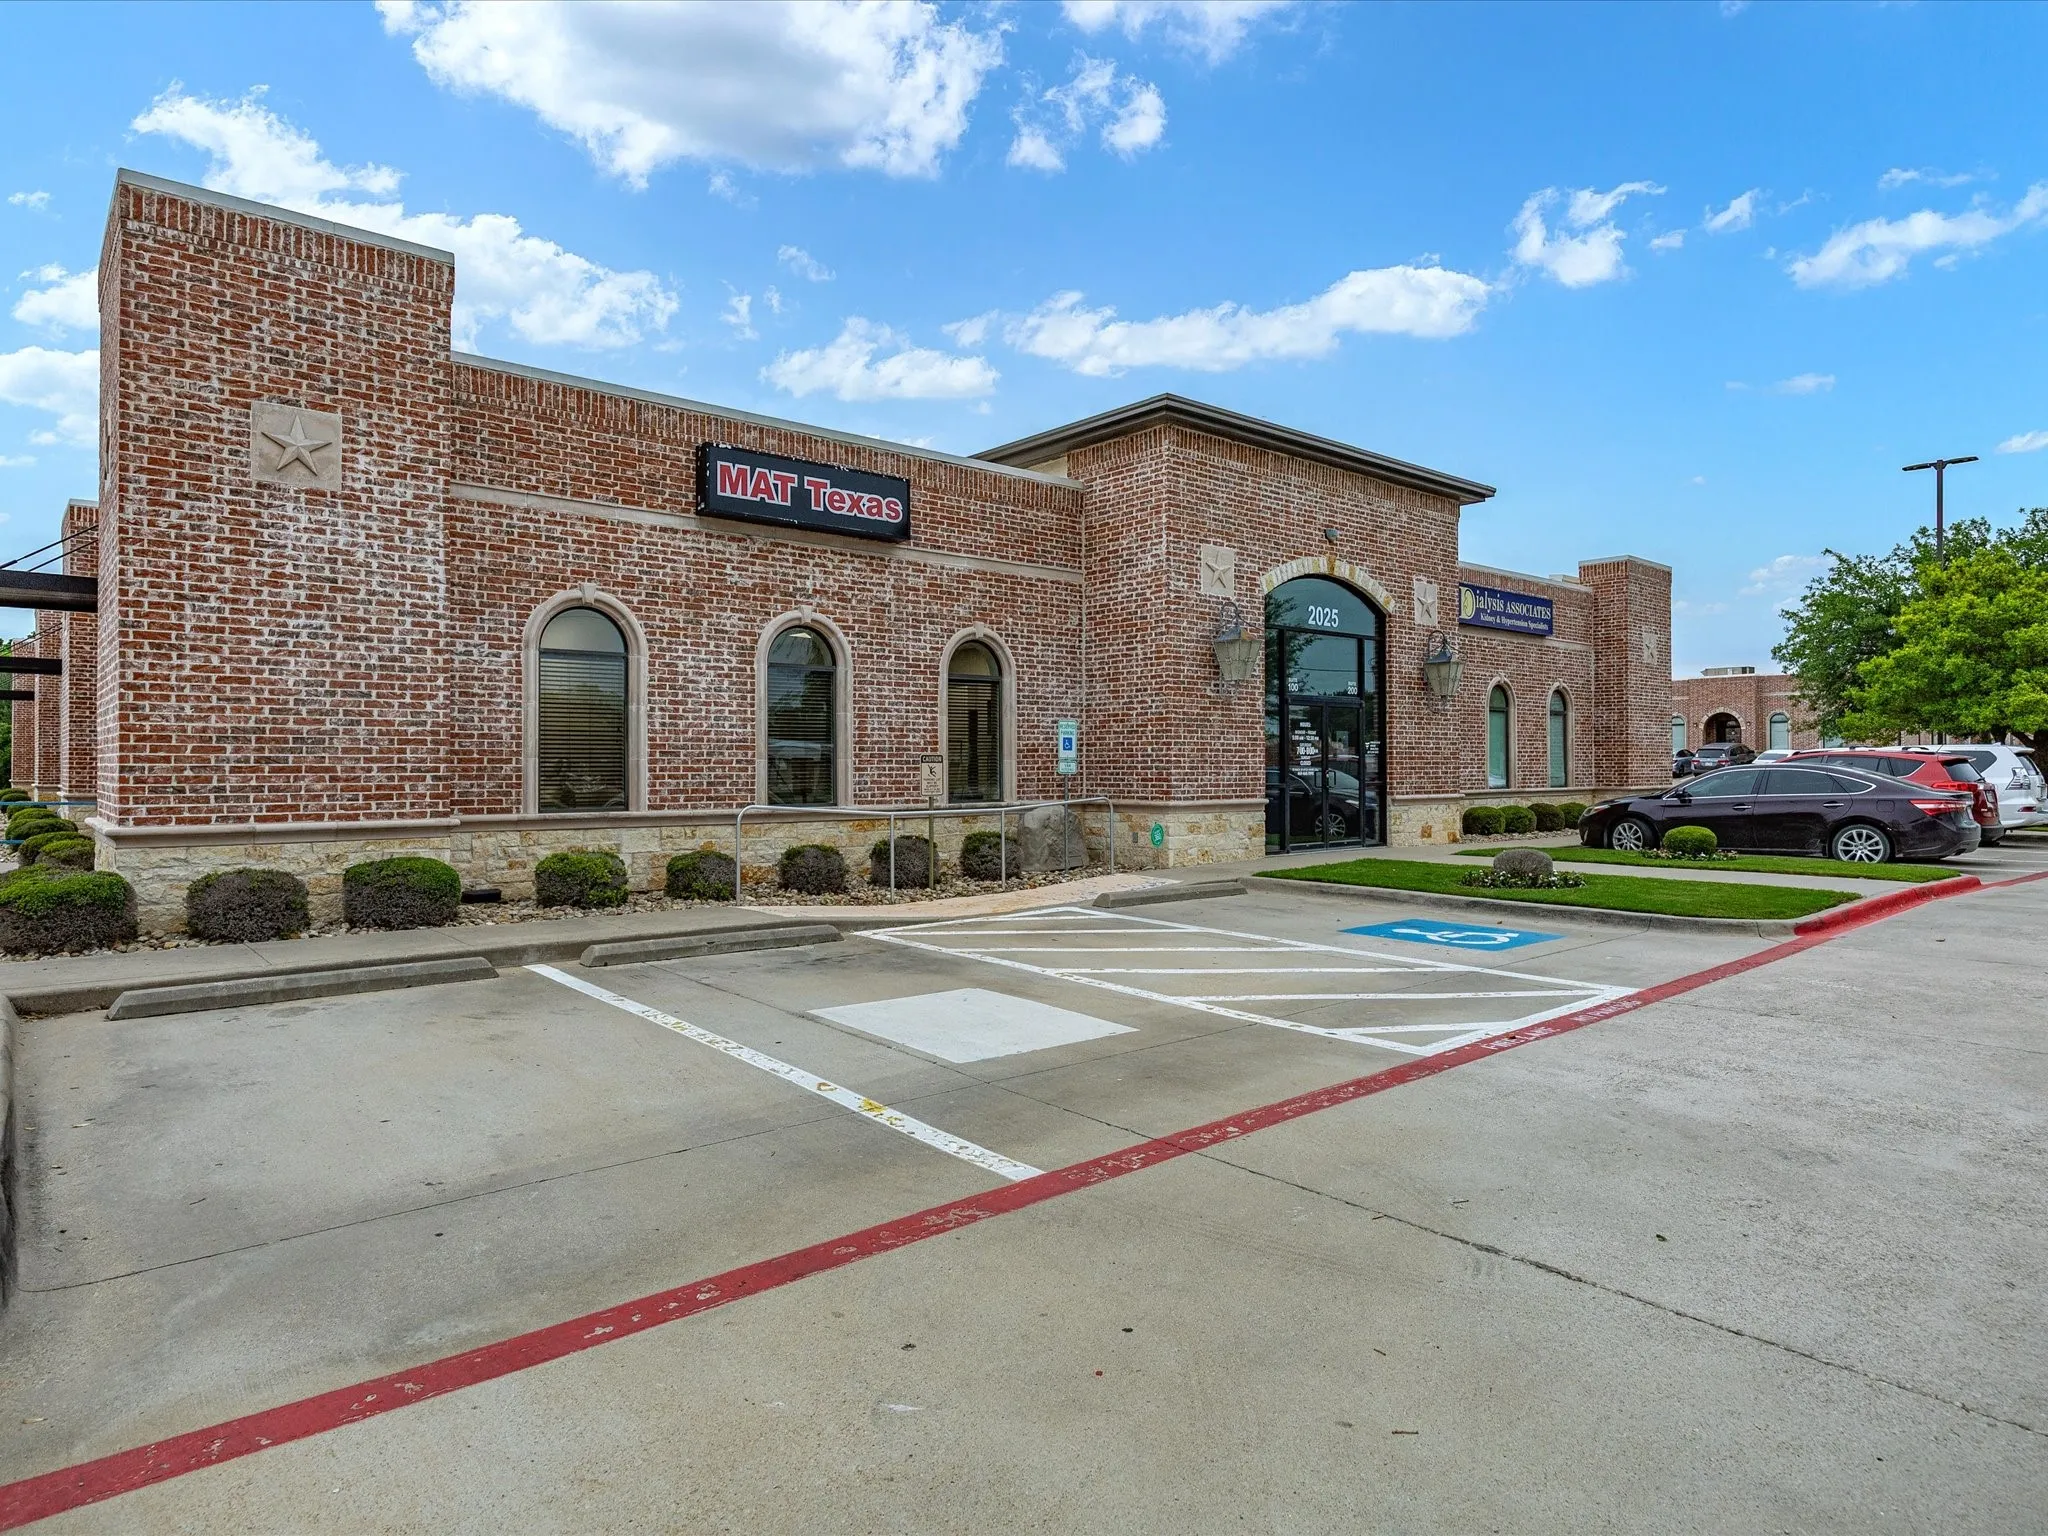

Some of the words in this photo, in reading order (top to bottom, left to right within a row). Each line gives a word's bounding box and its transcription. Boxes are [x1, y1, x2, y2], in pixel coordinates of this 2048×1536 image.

[717, 461, 798, 506] MAT
[804, 475, 903, 524] Texas
[1459, 586, 1505, 619] Dialysis
[1506, 601, 1551, 620] ASSOCIATES
[1308, 605, 1339, 628] 2025
[1480, 612, 1496, 624] Kidney
[1501, 616, 1528, 628] Hypertension
[1288, 683, 1299, 692] 100
[1347, 686, 1358, 695] 200
